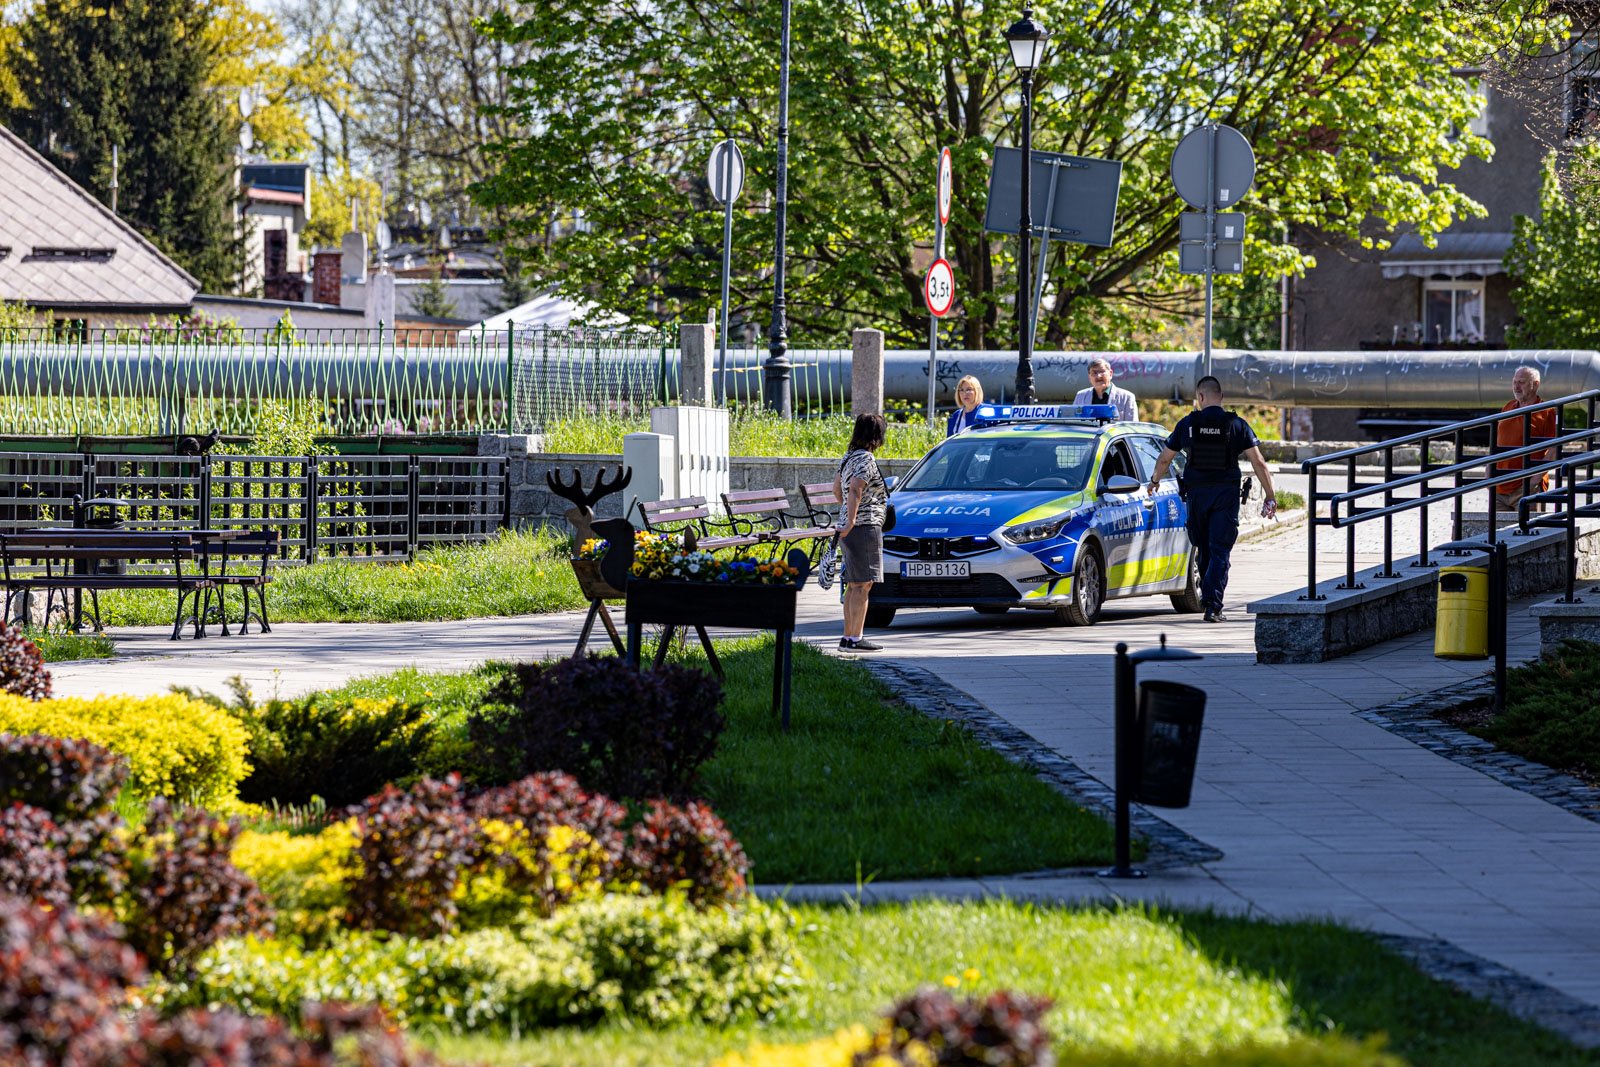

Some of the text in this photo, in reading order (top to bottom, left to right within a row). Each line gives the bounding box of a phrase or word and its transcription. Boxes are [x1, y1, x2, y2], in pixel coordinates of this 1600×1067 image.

[930, 276, 950, 300] 3,5t
[1011, 407, 1055, 418] POLICJA
[1200, 427, 1220, 435] POLICJA
[903, 506, 991, 517] POLICJA
[1110, 506, 1145, 531] POLICJA
[908, 563, 966, 576] HPB B136
